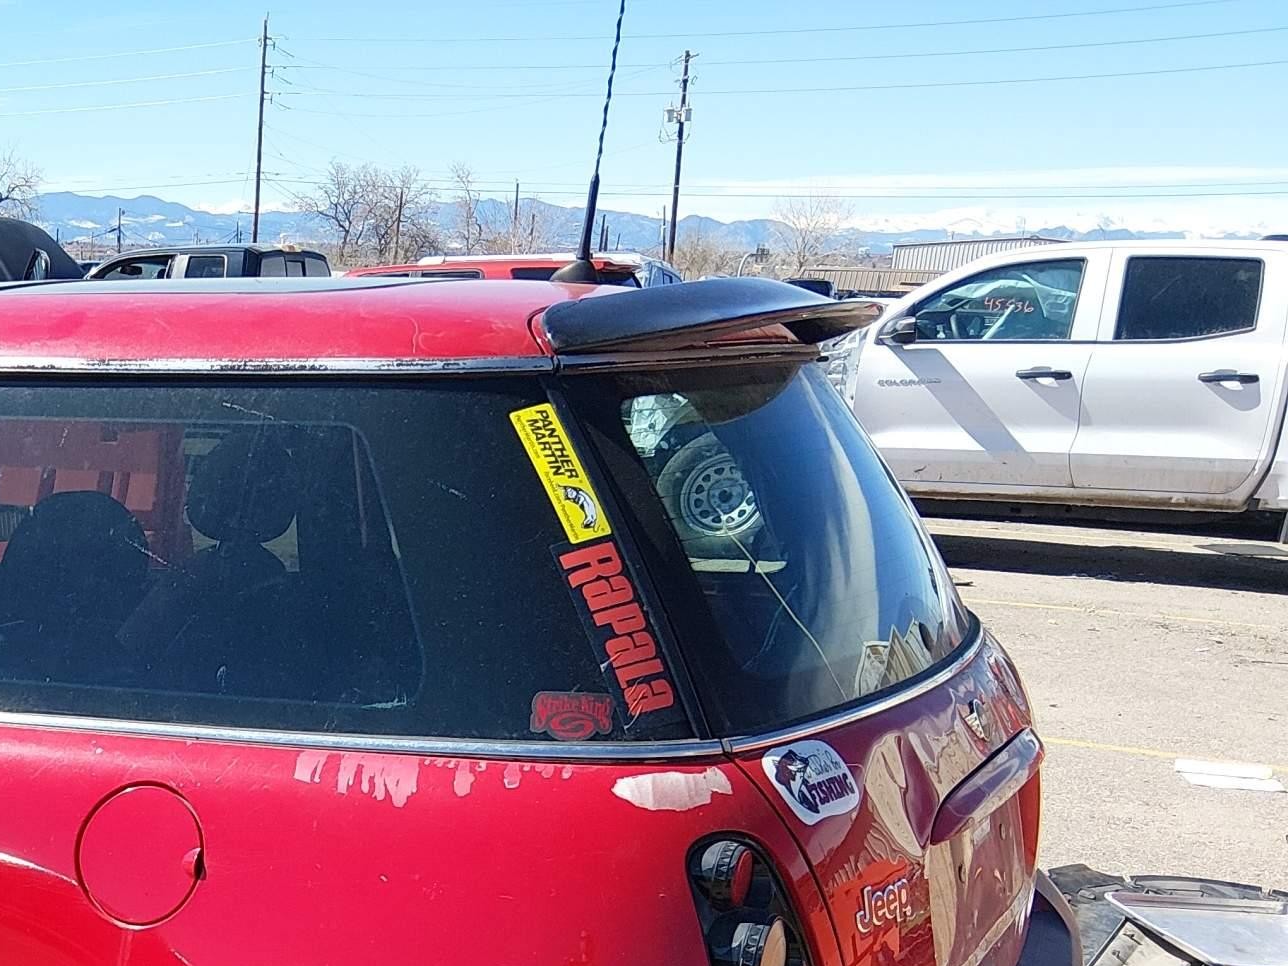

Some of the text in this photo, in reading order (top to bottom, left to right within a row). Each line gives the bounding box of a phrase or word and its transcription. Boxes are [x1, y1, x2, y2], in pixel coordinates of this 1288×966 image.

[526, 417, 565, 478] MARTIN
[535, 409, 580, 480] PANTHER
[807, 772, 856, 807] FISHING
[856, 878, 911, 935] Jeep
